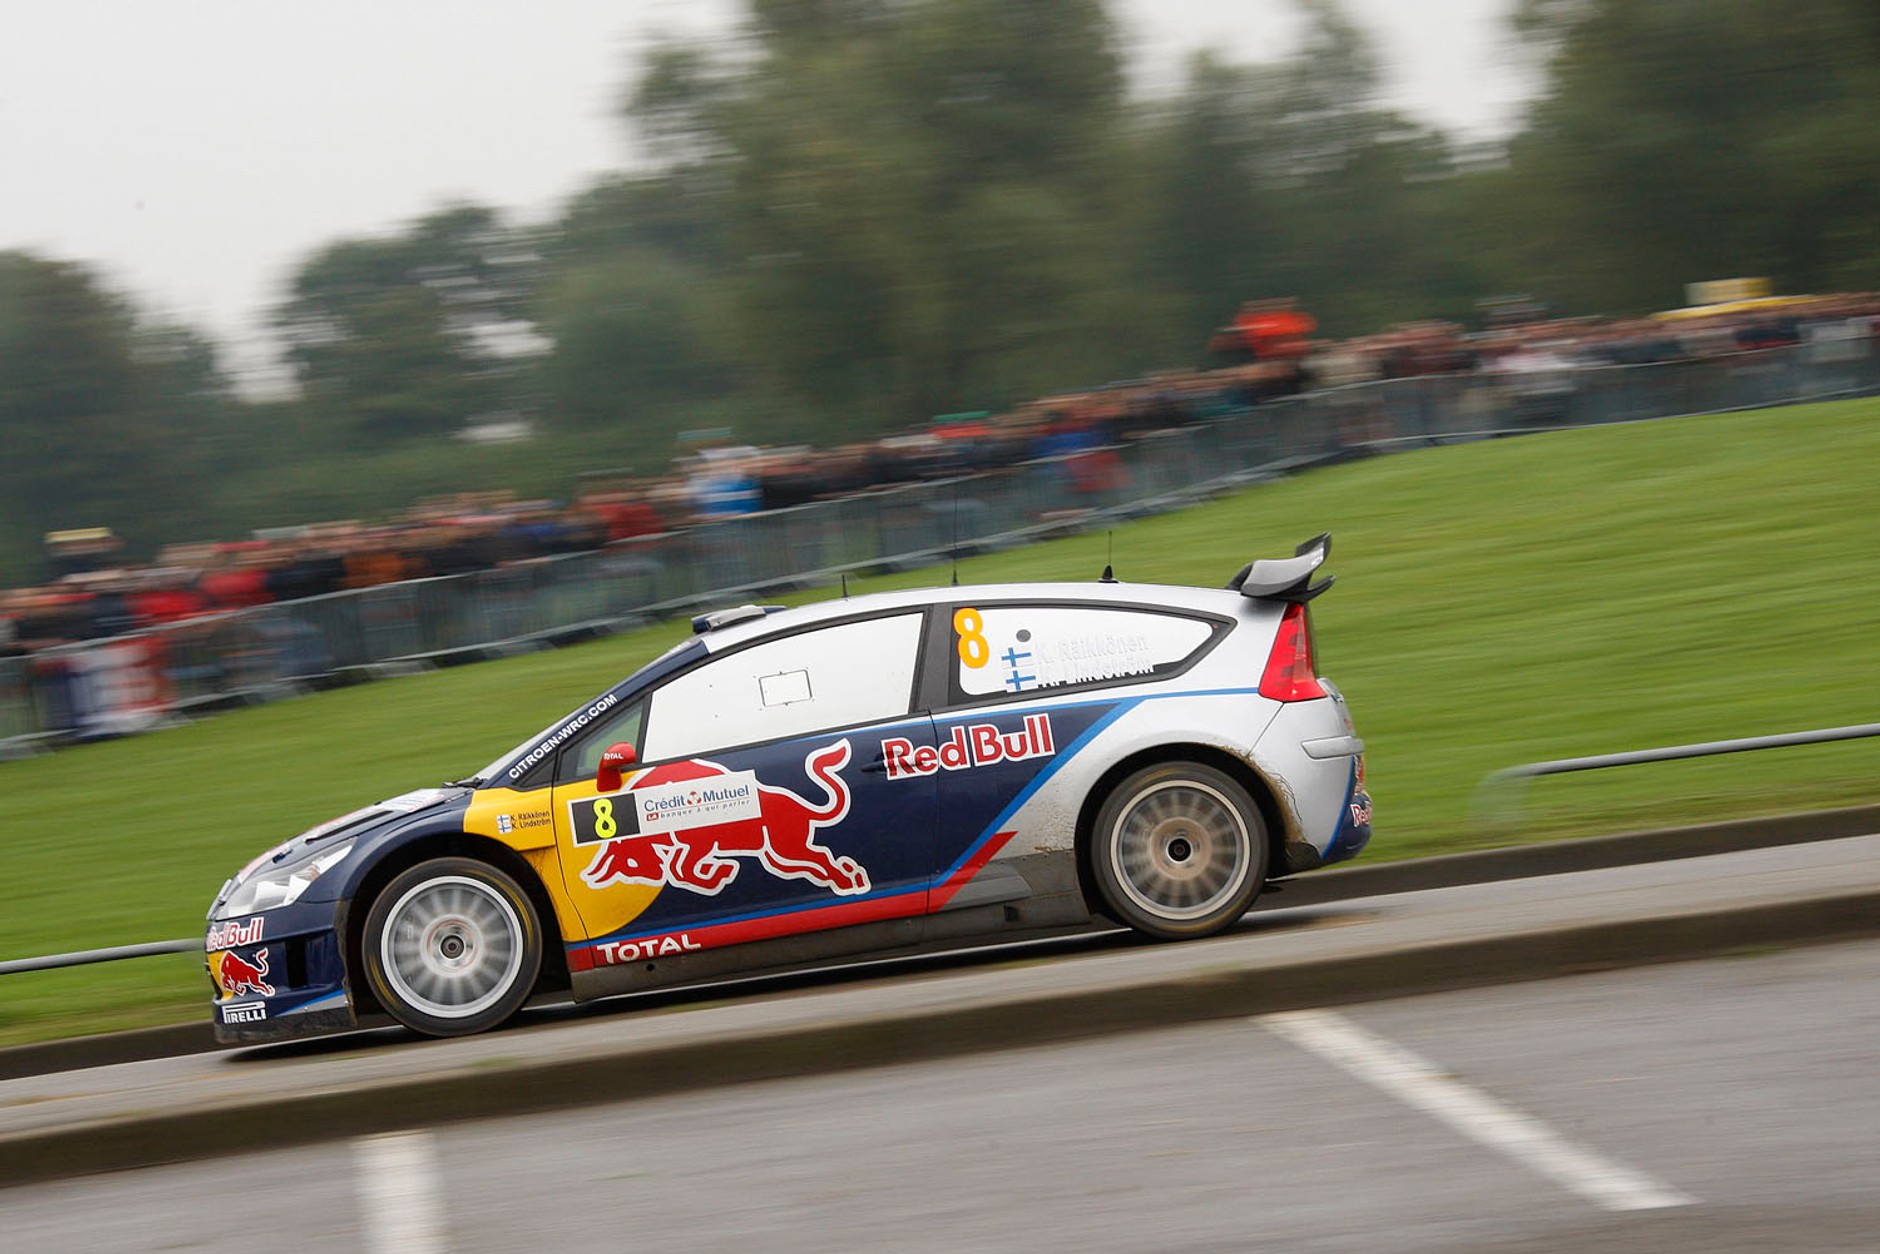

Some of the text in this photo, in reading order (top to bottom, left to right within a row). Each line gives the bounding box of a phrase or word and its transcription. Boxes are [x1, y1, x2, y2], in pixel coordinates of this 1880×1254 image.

[953, 608, 989, 668] 8
[508, 694, 617, 779] CITROEN-WRC.COM
[644, 785, 749, 812] Crédit Mutuel
[593, 798, 617, 838] 8
[597, 934, 701, 964] TOTAL
[221, 1001, 267, 1024] PIRELLI
